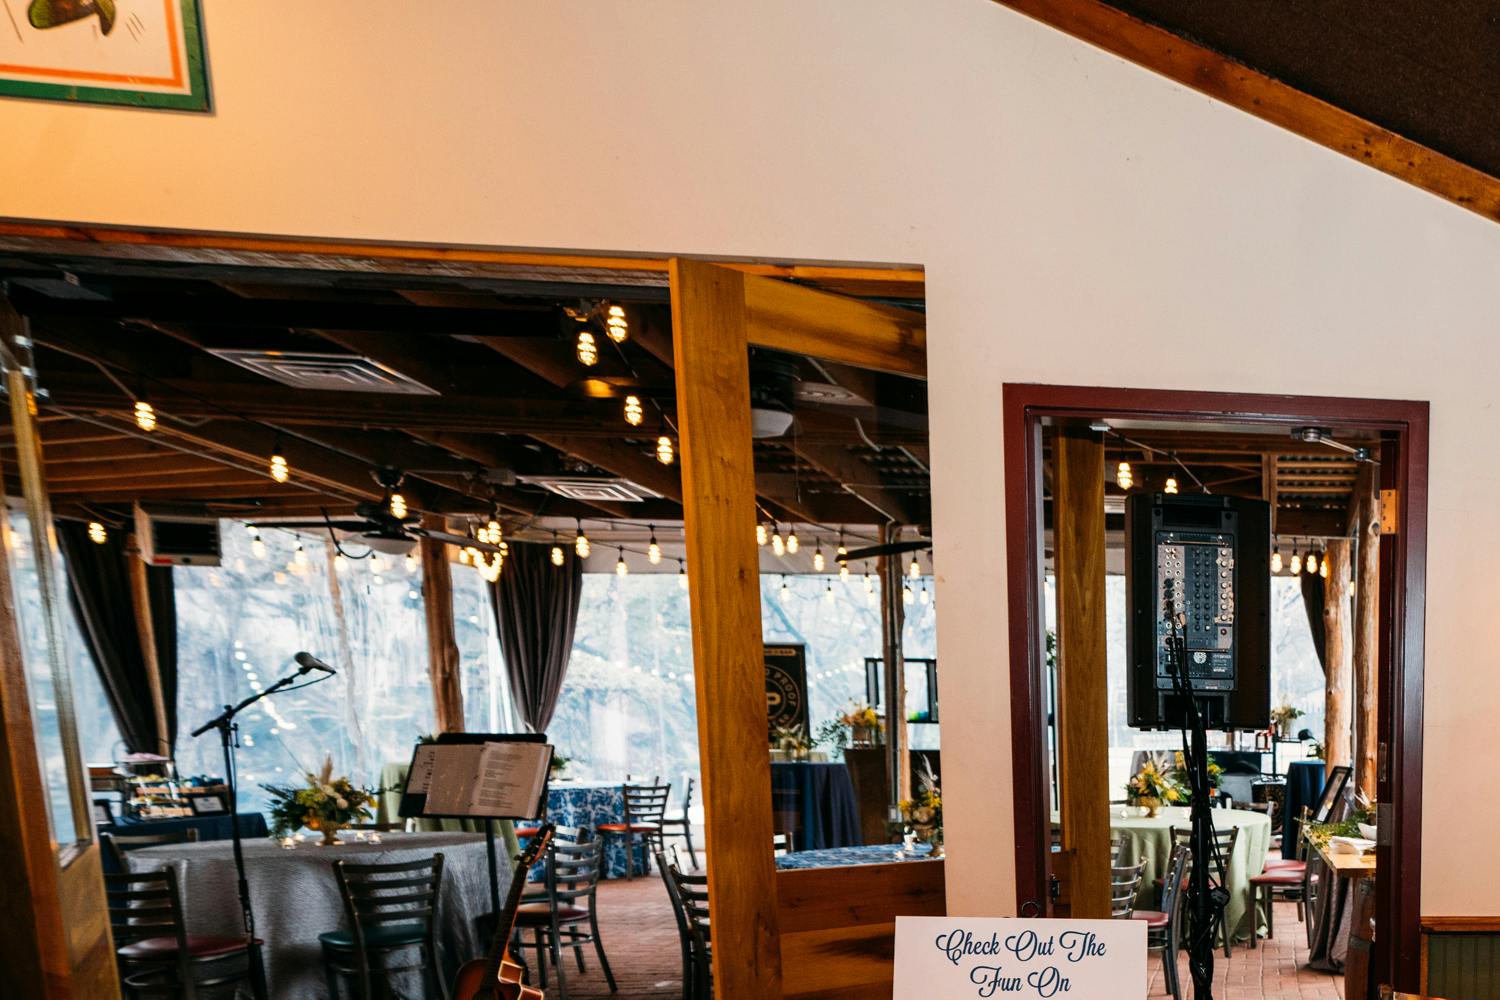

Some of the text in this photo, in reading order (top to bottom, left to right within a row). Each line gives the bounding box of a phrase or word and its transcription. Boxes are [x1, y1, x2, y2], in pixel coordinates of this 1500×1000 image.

[935, 929, 1106, 965] Check Out The
[970, 966, 1071, 998] Fun On
